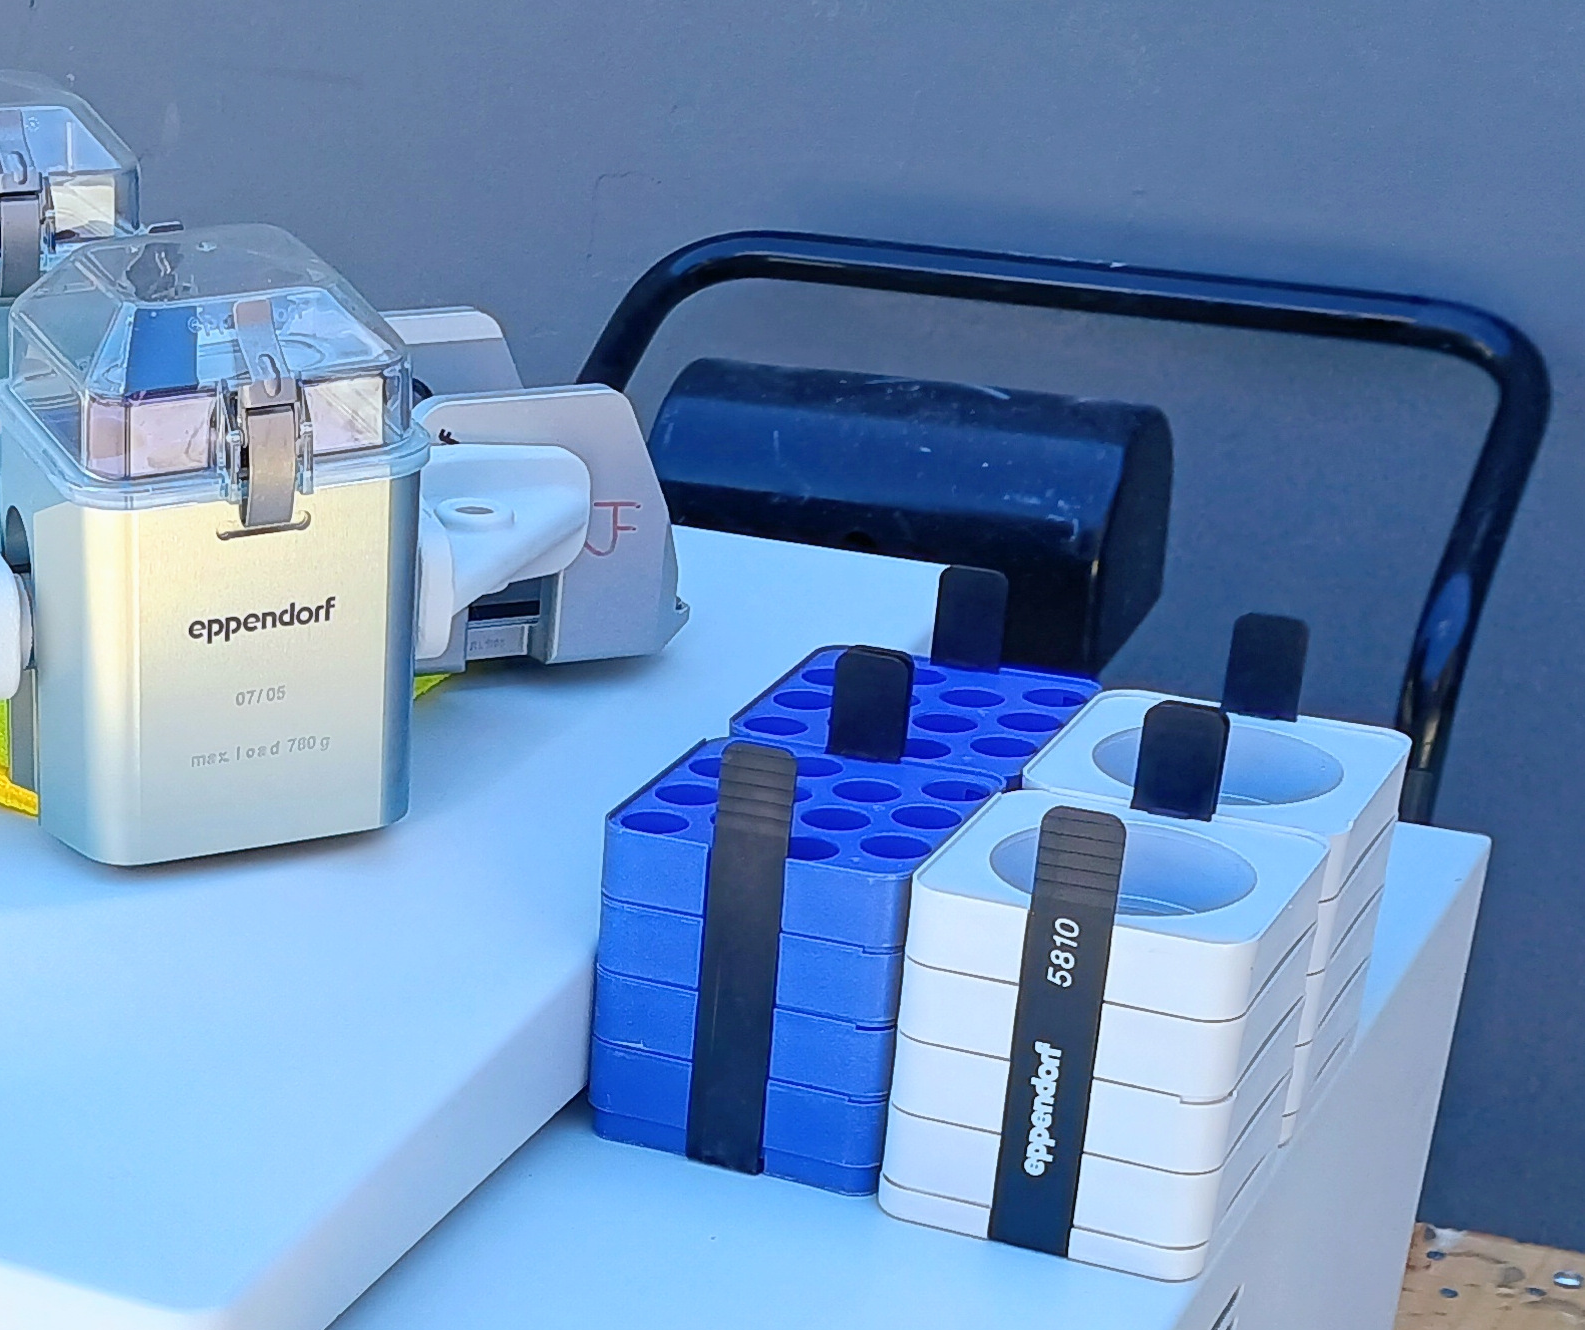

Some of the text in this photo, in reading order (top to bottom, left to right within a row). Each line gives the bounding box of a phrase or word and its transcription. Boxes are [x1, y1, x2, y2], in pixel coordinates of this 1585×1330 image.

[188, 596, 336, 645] eppendorf
[1047, 917, 1080, 988] 5810
[1023, 1041, 1062, 1177] eppendorf
